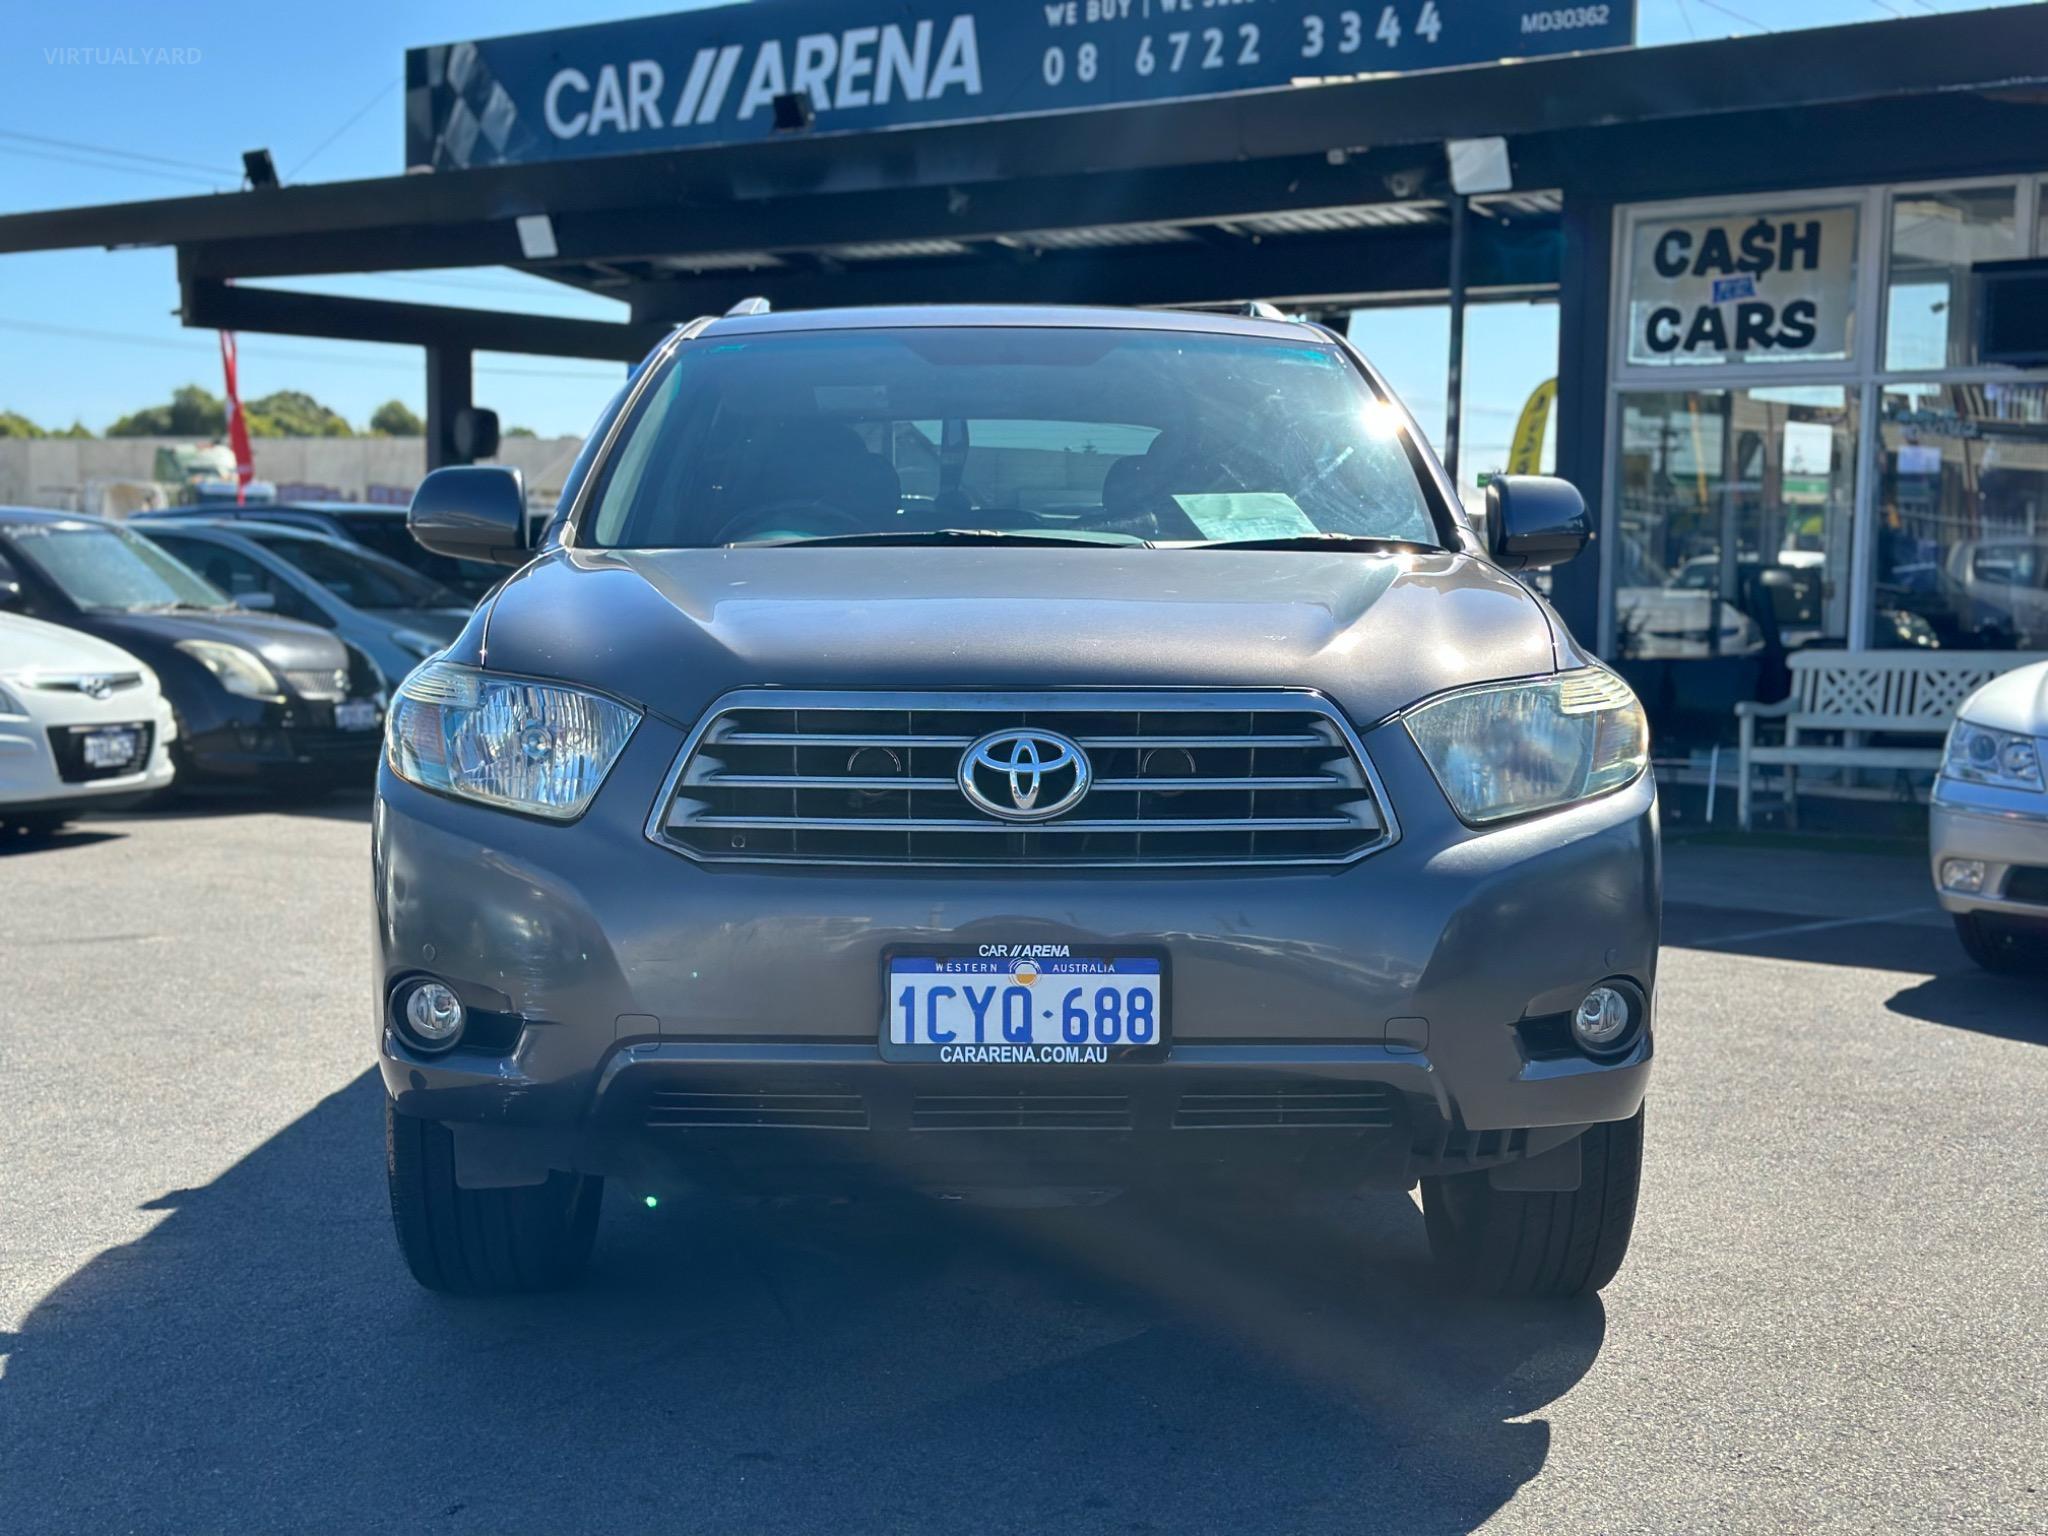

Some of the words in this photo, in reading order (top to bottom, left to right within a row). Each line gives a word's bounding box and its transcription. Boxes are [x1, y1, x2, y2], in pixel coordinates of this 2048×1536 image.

[1045, 2, 1078, 26] WE
[1086, 0, 1131, 23] BUY
[1521, 4, 1610, 34] MD30362
[1043, 42, 1098, 86] 08
[1135, 23, 1261, 76] 6722
[1301, 1, 1442, 57] 3344
[545, 59, 663, 139] CAR
[1646, 299, 1817, 353] CARS
[978, 944, 1008, 957] CAR
[935, 963, 998, 973] WESTERN
[1051, 963, 1116, 973] AUSTRALIA
[940, 1046, 1108, 1063] CARARENA.COM.AU
